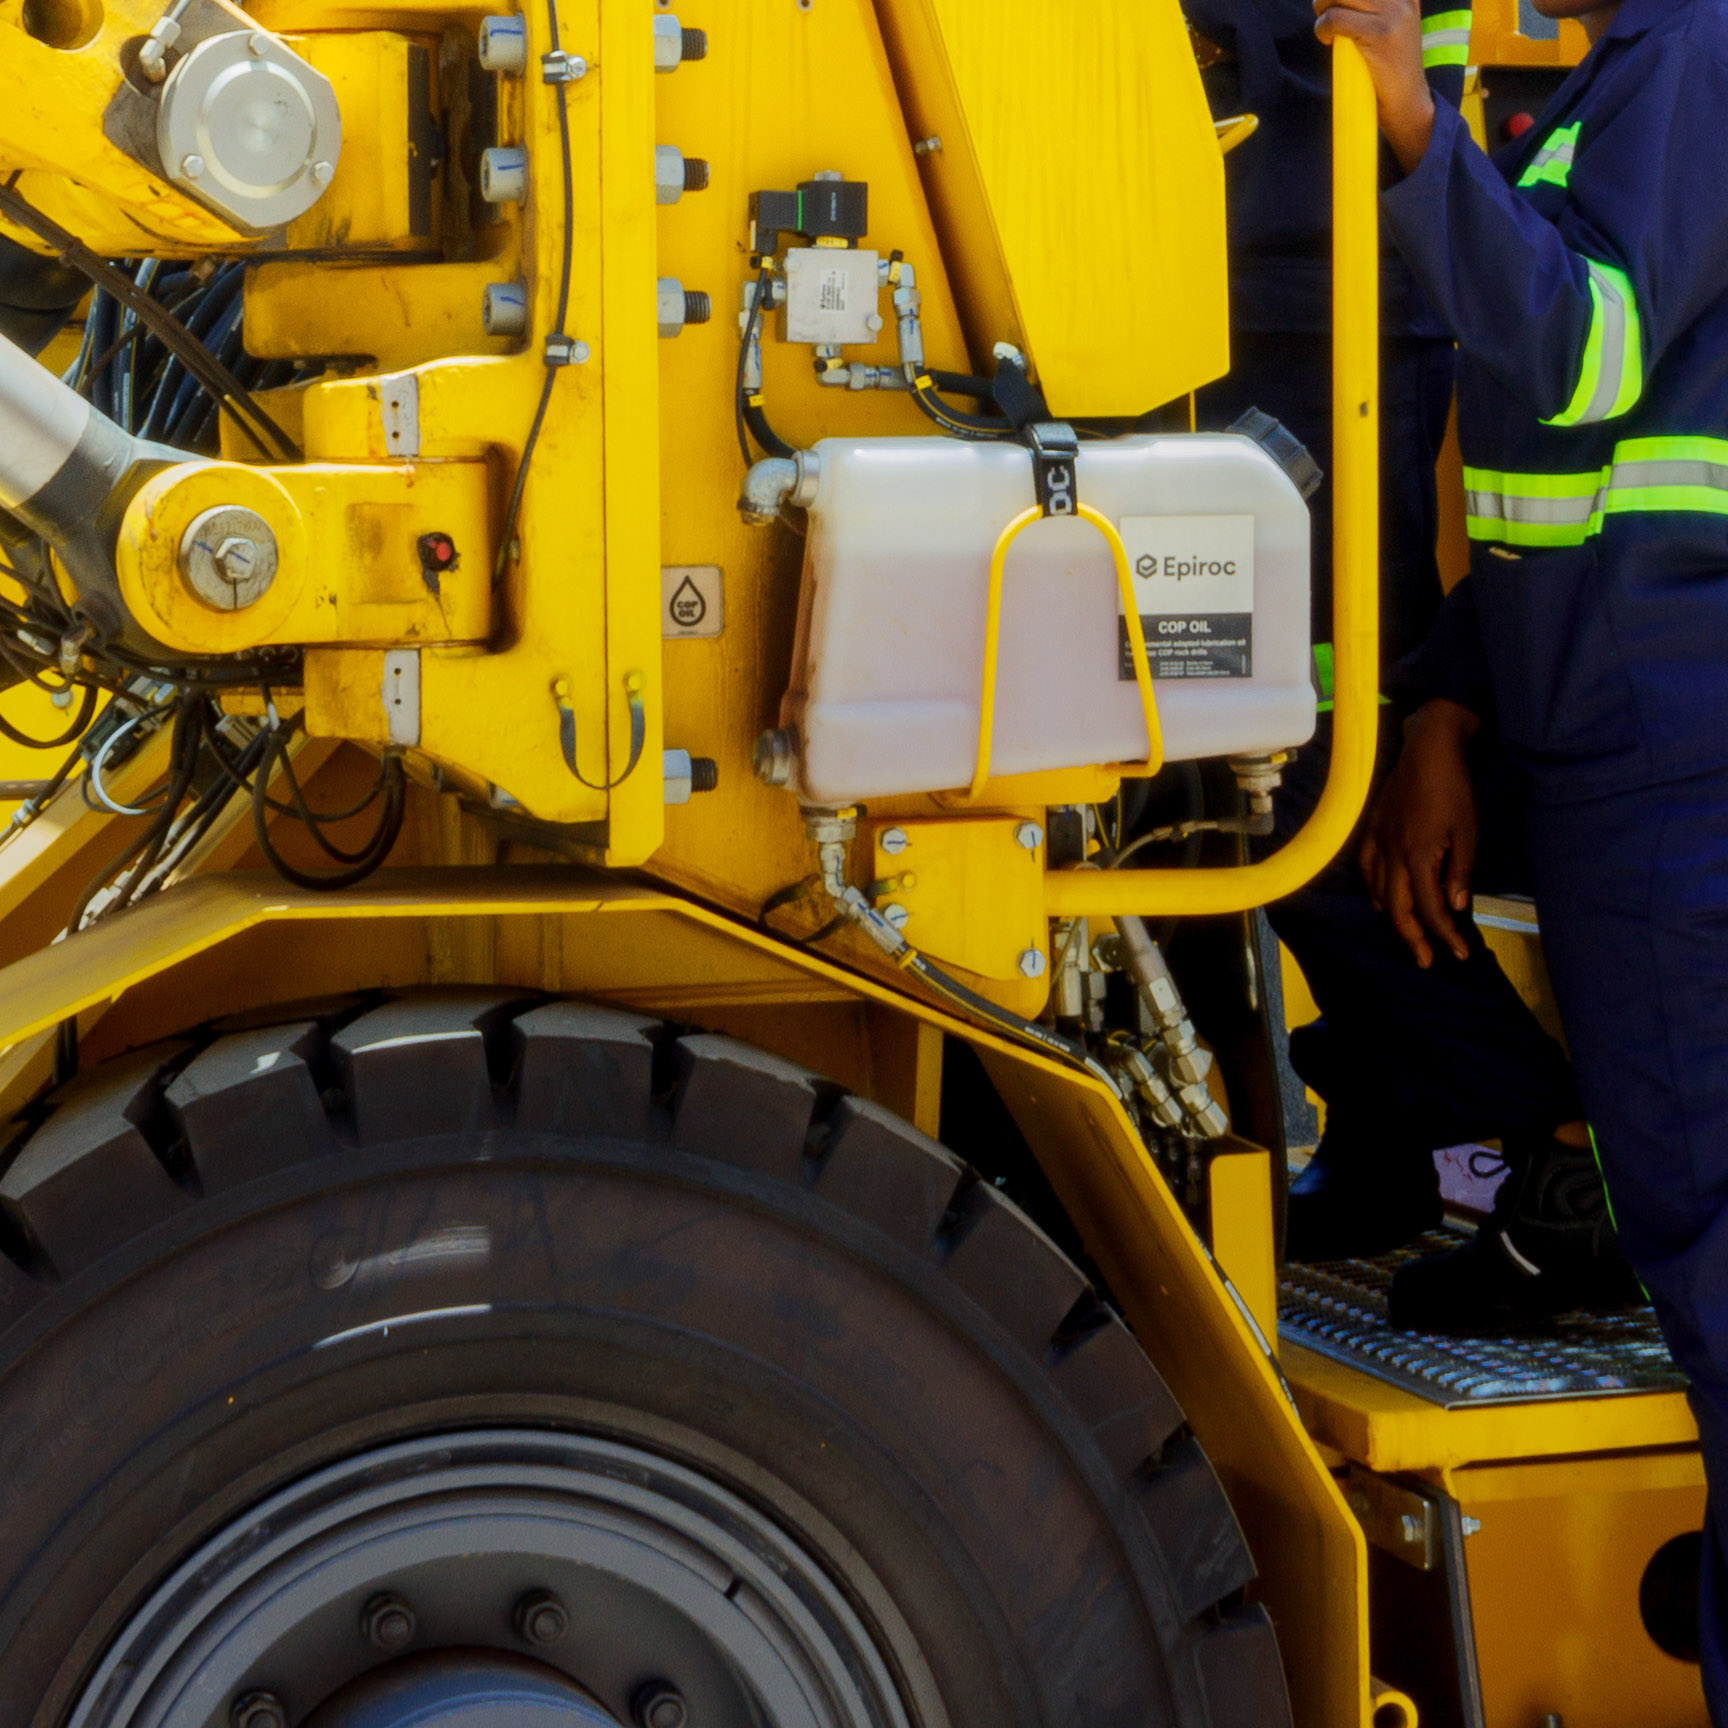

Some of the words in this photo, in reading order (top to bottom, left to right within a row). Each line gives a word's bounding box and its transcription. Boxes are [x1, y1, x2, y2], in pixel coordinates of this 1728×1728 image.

[1163, 554, 1236, 582] Epiroc
[676, 601, 699, 609] COP
[1158, 620, 1188, 634] COP
[1188, 619, 1212, 633] OIL
